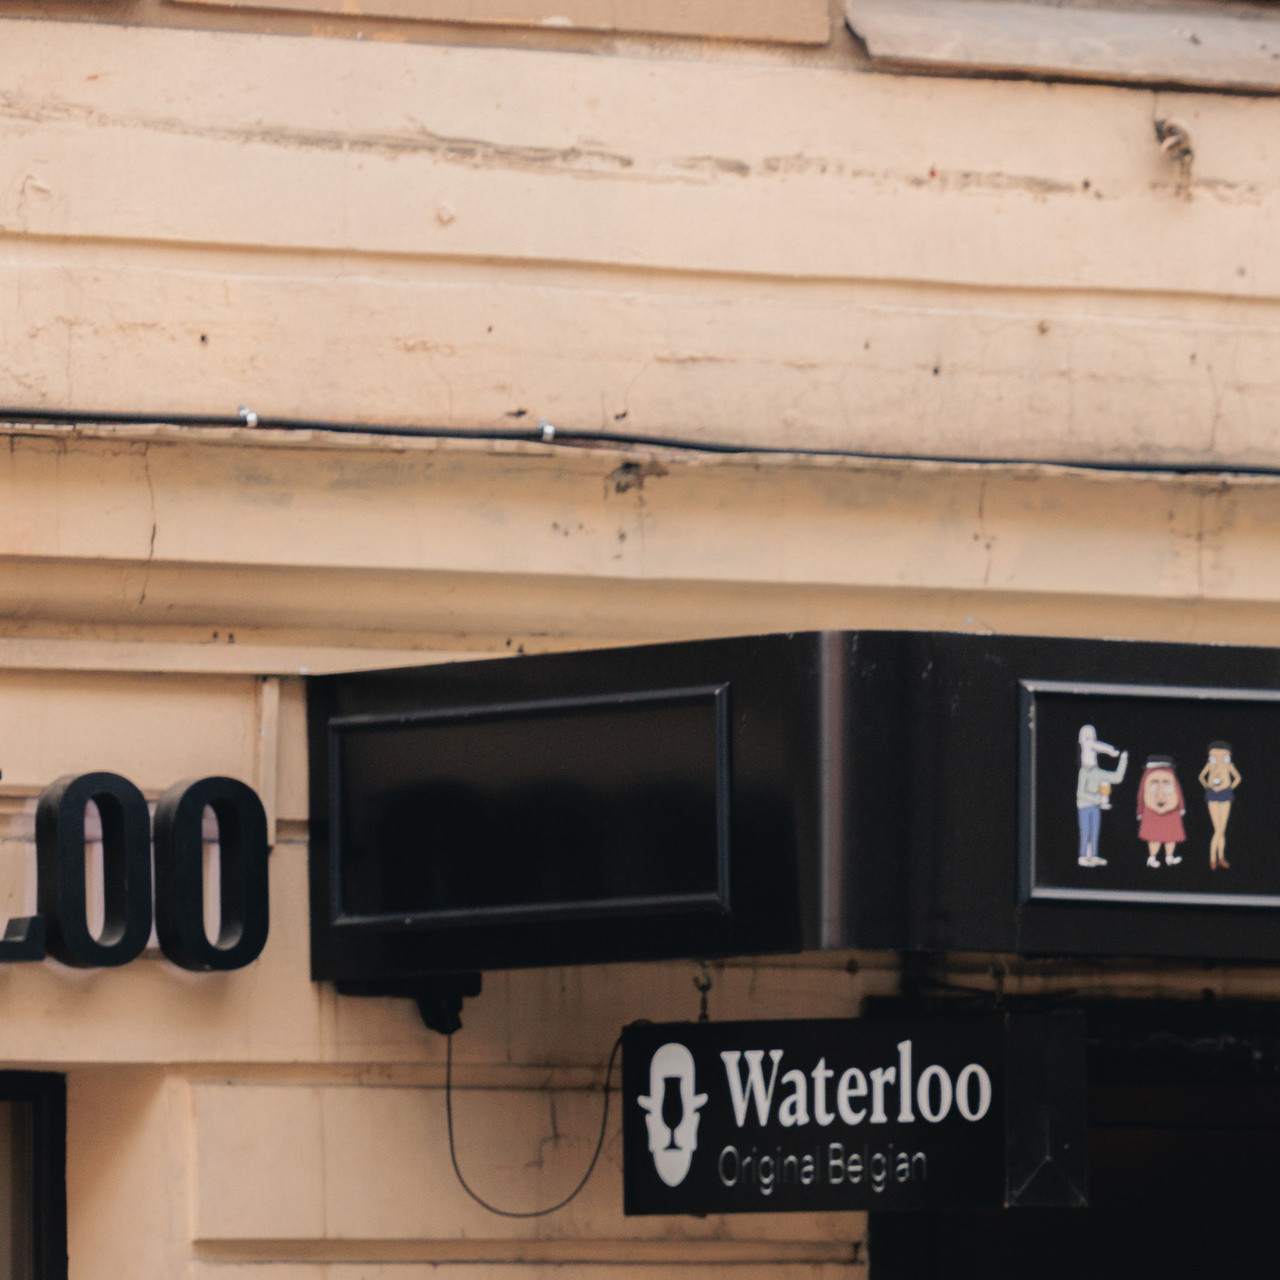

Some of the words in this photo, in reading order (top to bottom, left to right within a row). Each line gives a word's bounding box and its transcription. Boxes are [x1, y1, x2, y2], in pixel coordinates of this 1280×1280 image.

[720, 1039, 992, 1128] Waterloo
[718, 1143, 820, 1197] Original
[827, 1142, 928, 1194] Belgian
